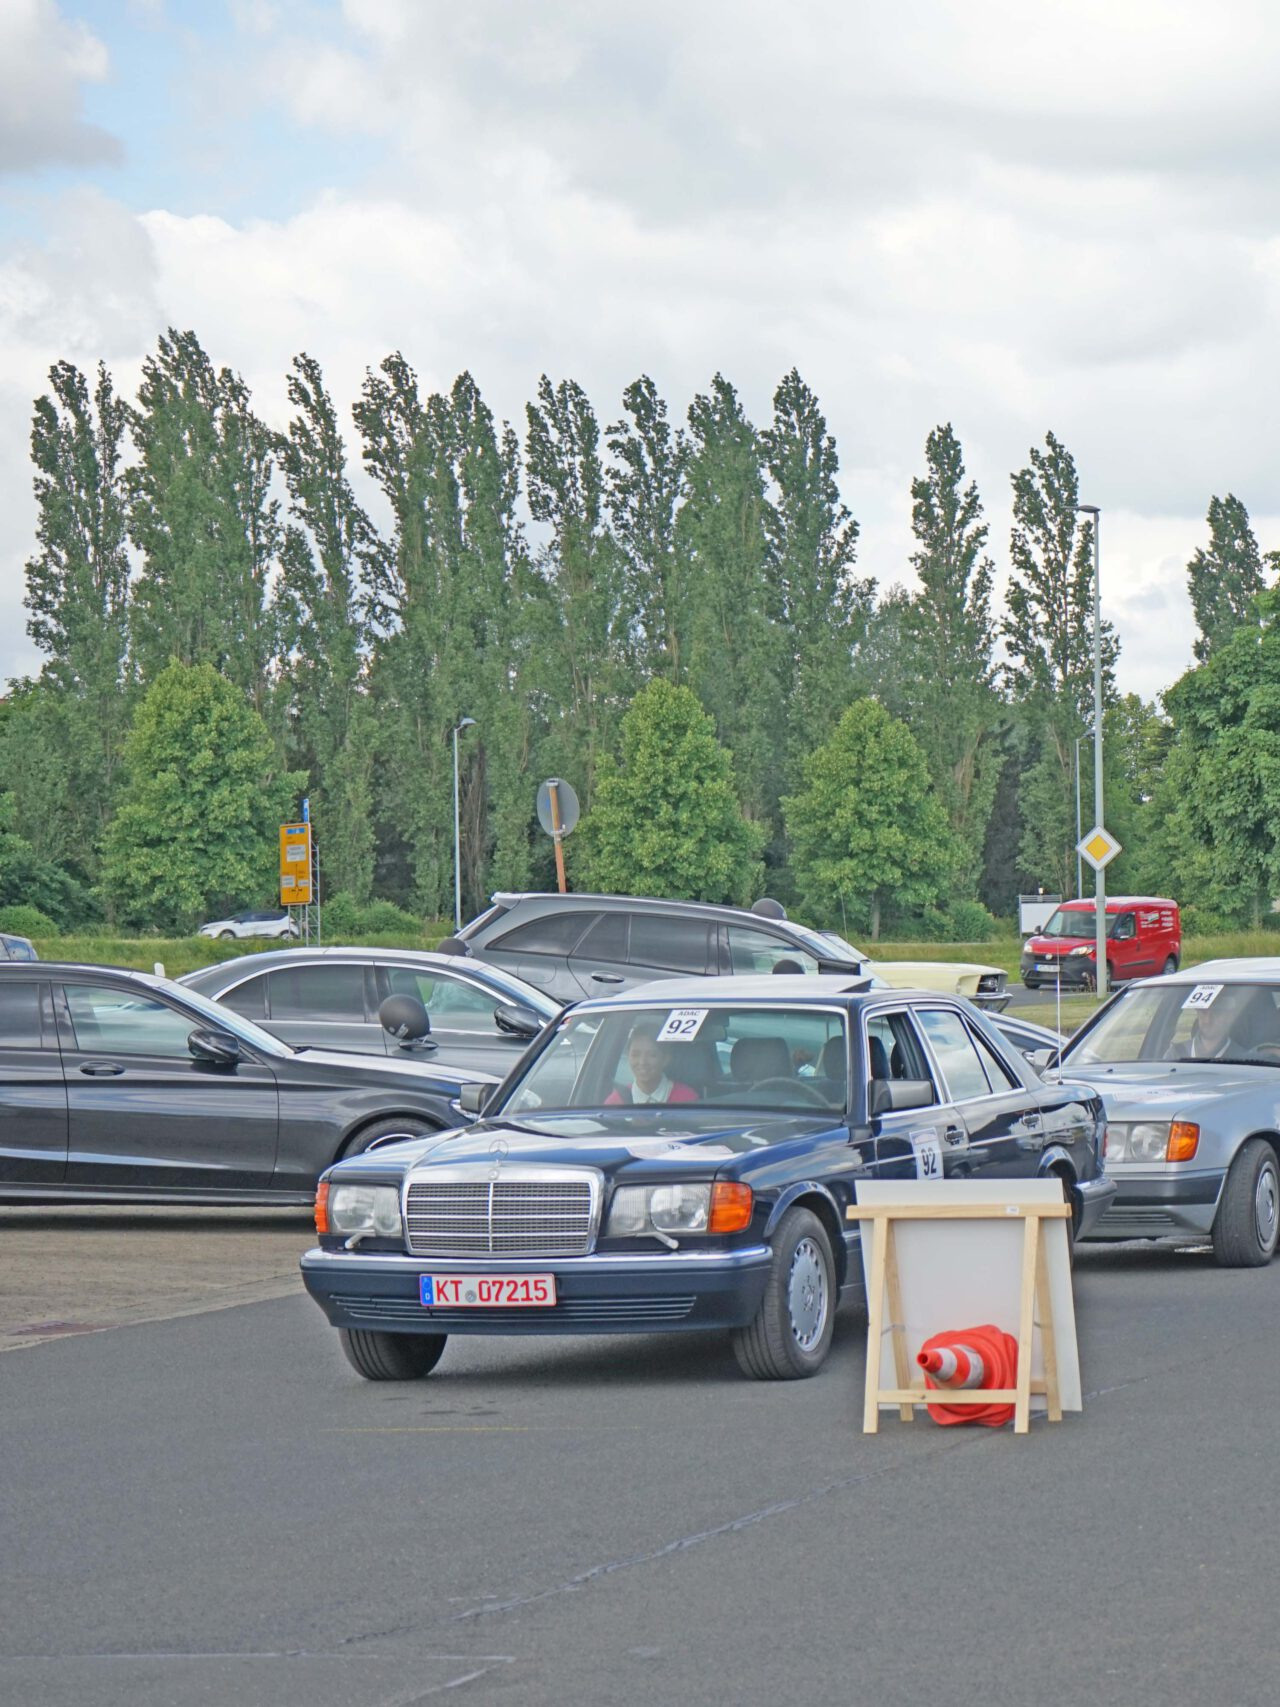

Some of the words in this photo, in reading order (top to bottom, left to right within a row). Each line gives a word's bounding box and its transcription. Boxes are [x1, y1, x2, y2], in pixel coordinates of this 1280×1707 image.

[1190, 991, 1214, 1003] 94
[666, 1019, 697, 1034] 92
[920, 1147, 937, 1176] 92
[435, 1279, 463, 1302] KT
[478, 1279, 548, 1302] 07215
